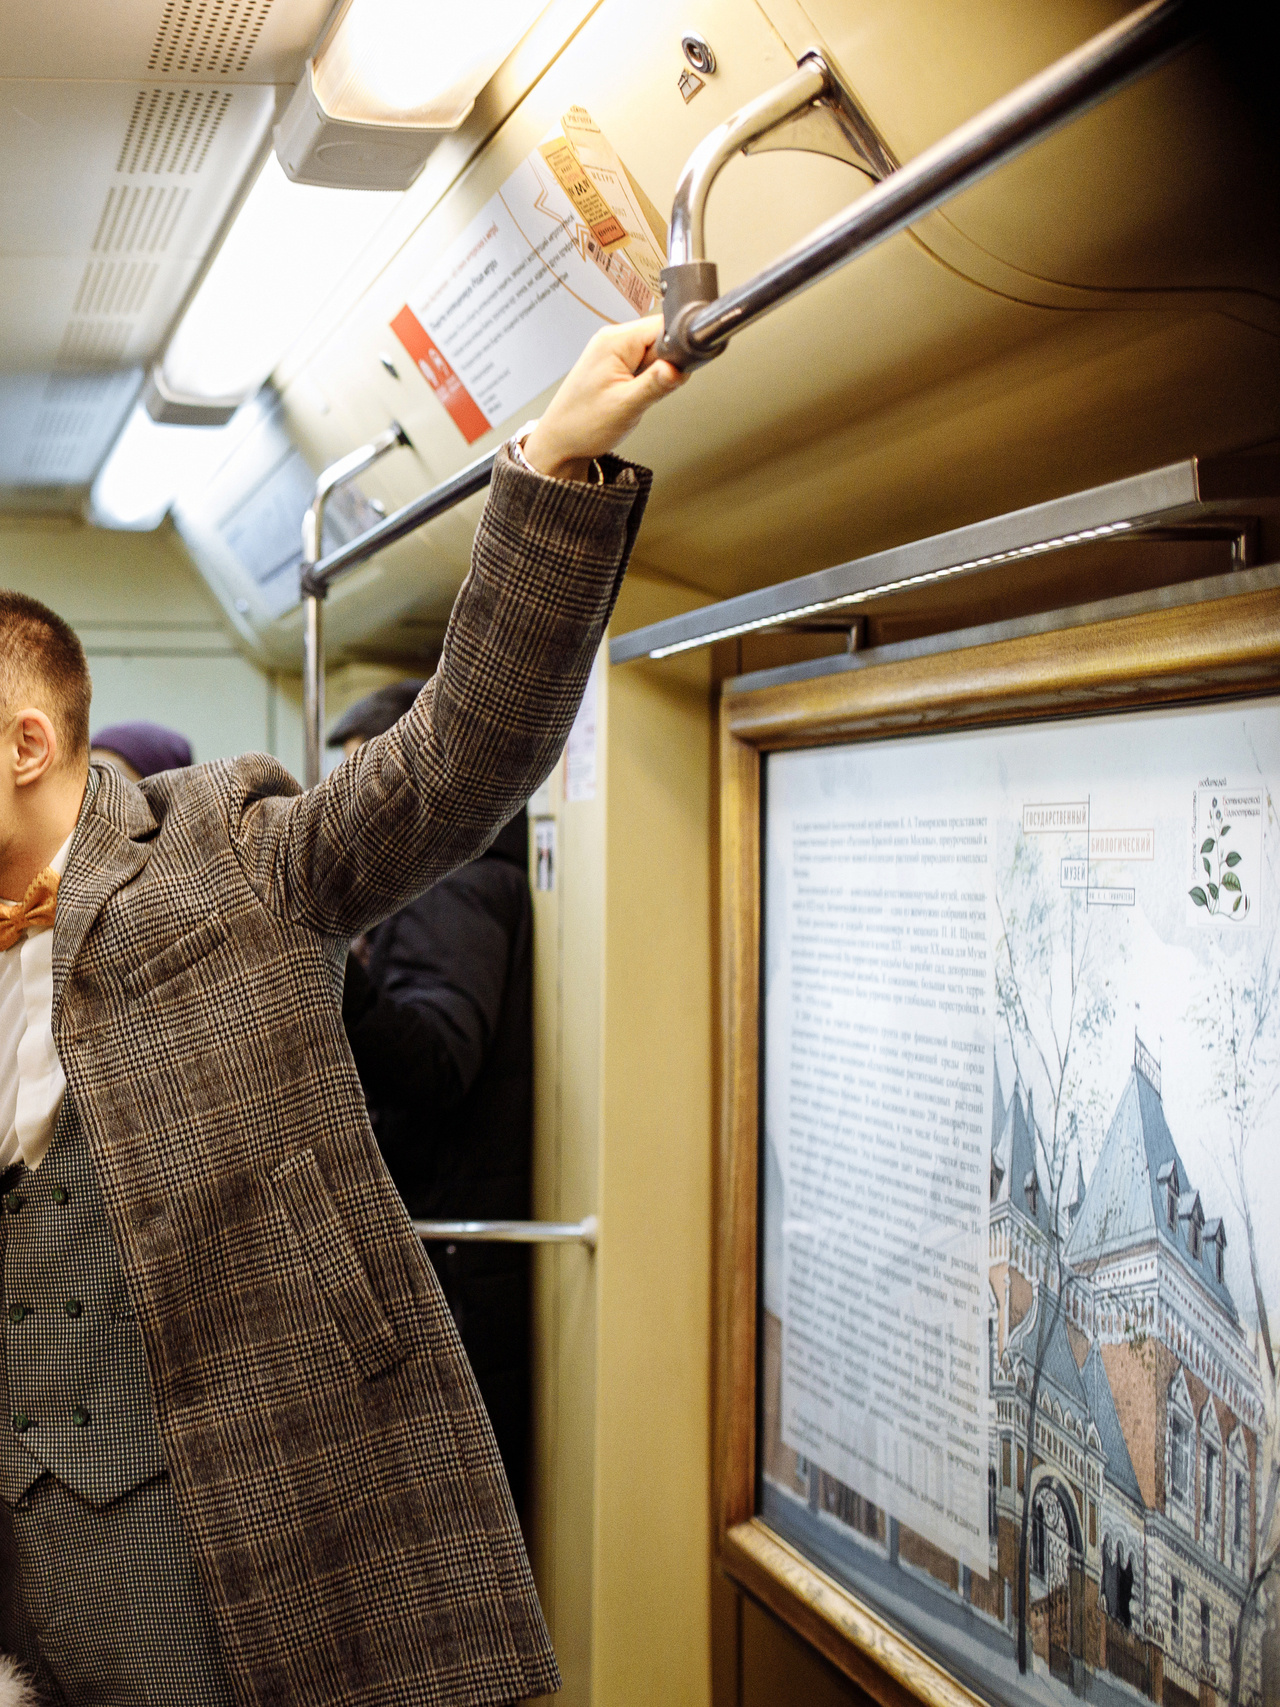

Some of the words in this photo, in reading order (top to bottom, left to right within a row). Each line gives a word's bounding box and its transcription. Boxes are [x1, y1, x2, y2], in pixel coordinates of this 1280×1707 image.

[1026, 806, 1087, 827] ГОСУДАРСТВЕННЫЙ
[949, 818, 988, 831] представляет
[940, 833, 982, 847] приуроченный
[1091, 833, 1151, 853] БИОЛОГИЧЕСКИЙ
[957, 853, 988, 863] комплекса
[1064, 862, 1086, 881] МУЗЕЙ
[970, 911, 987, 923] музея
[968, 946, 988, 961] Музея
[939, 1001, 980, 1014] перестройках
[951, 1039, 986, 1054] поддержке
[964, 1061, 985, 1075] города
[947, 1078, 985, 1096] сообщества,
[955, 1099, 984, 1114] растений
